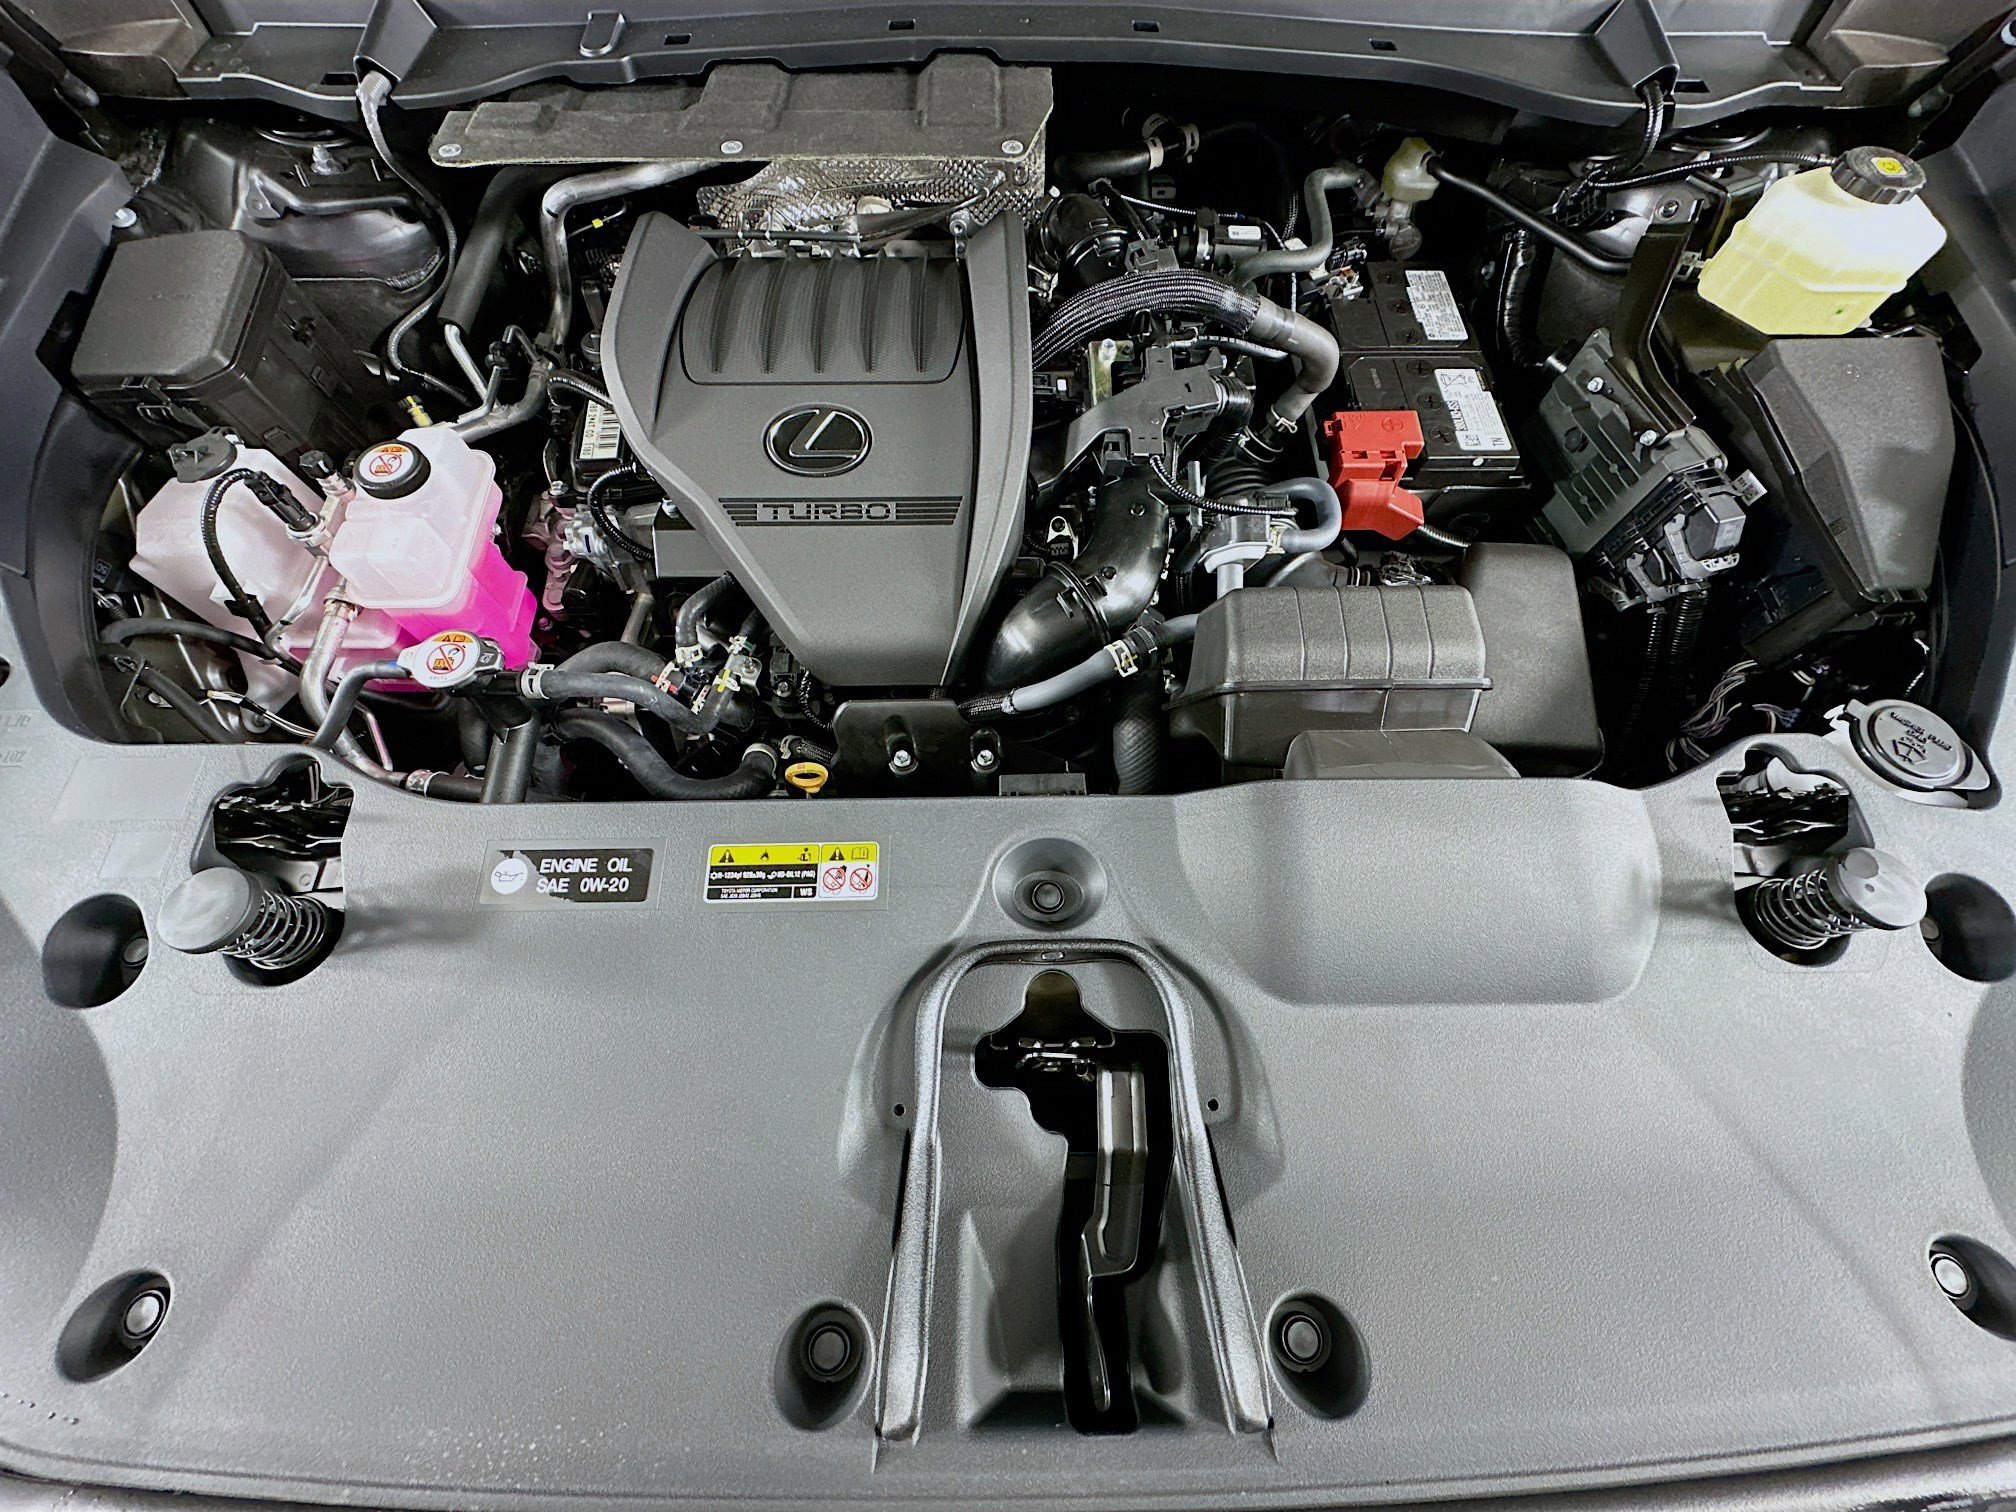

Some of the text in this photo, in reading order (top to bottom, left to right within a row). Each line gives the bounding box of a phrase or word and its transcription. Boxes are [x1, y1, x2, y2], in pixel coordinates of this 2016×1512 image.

[761, 502, 892, 521] TURBO
[539, 857, 633, 873] ENGINE OIL
[535, 876, 630, 893] SAE 0W-20
[799, 887, 813, 897] WS
